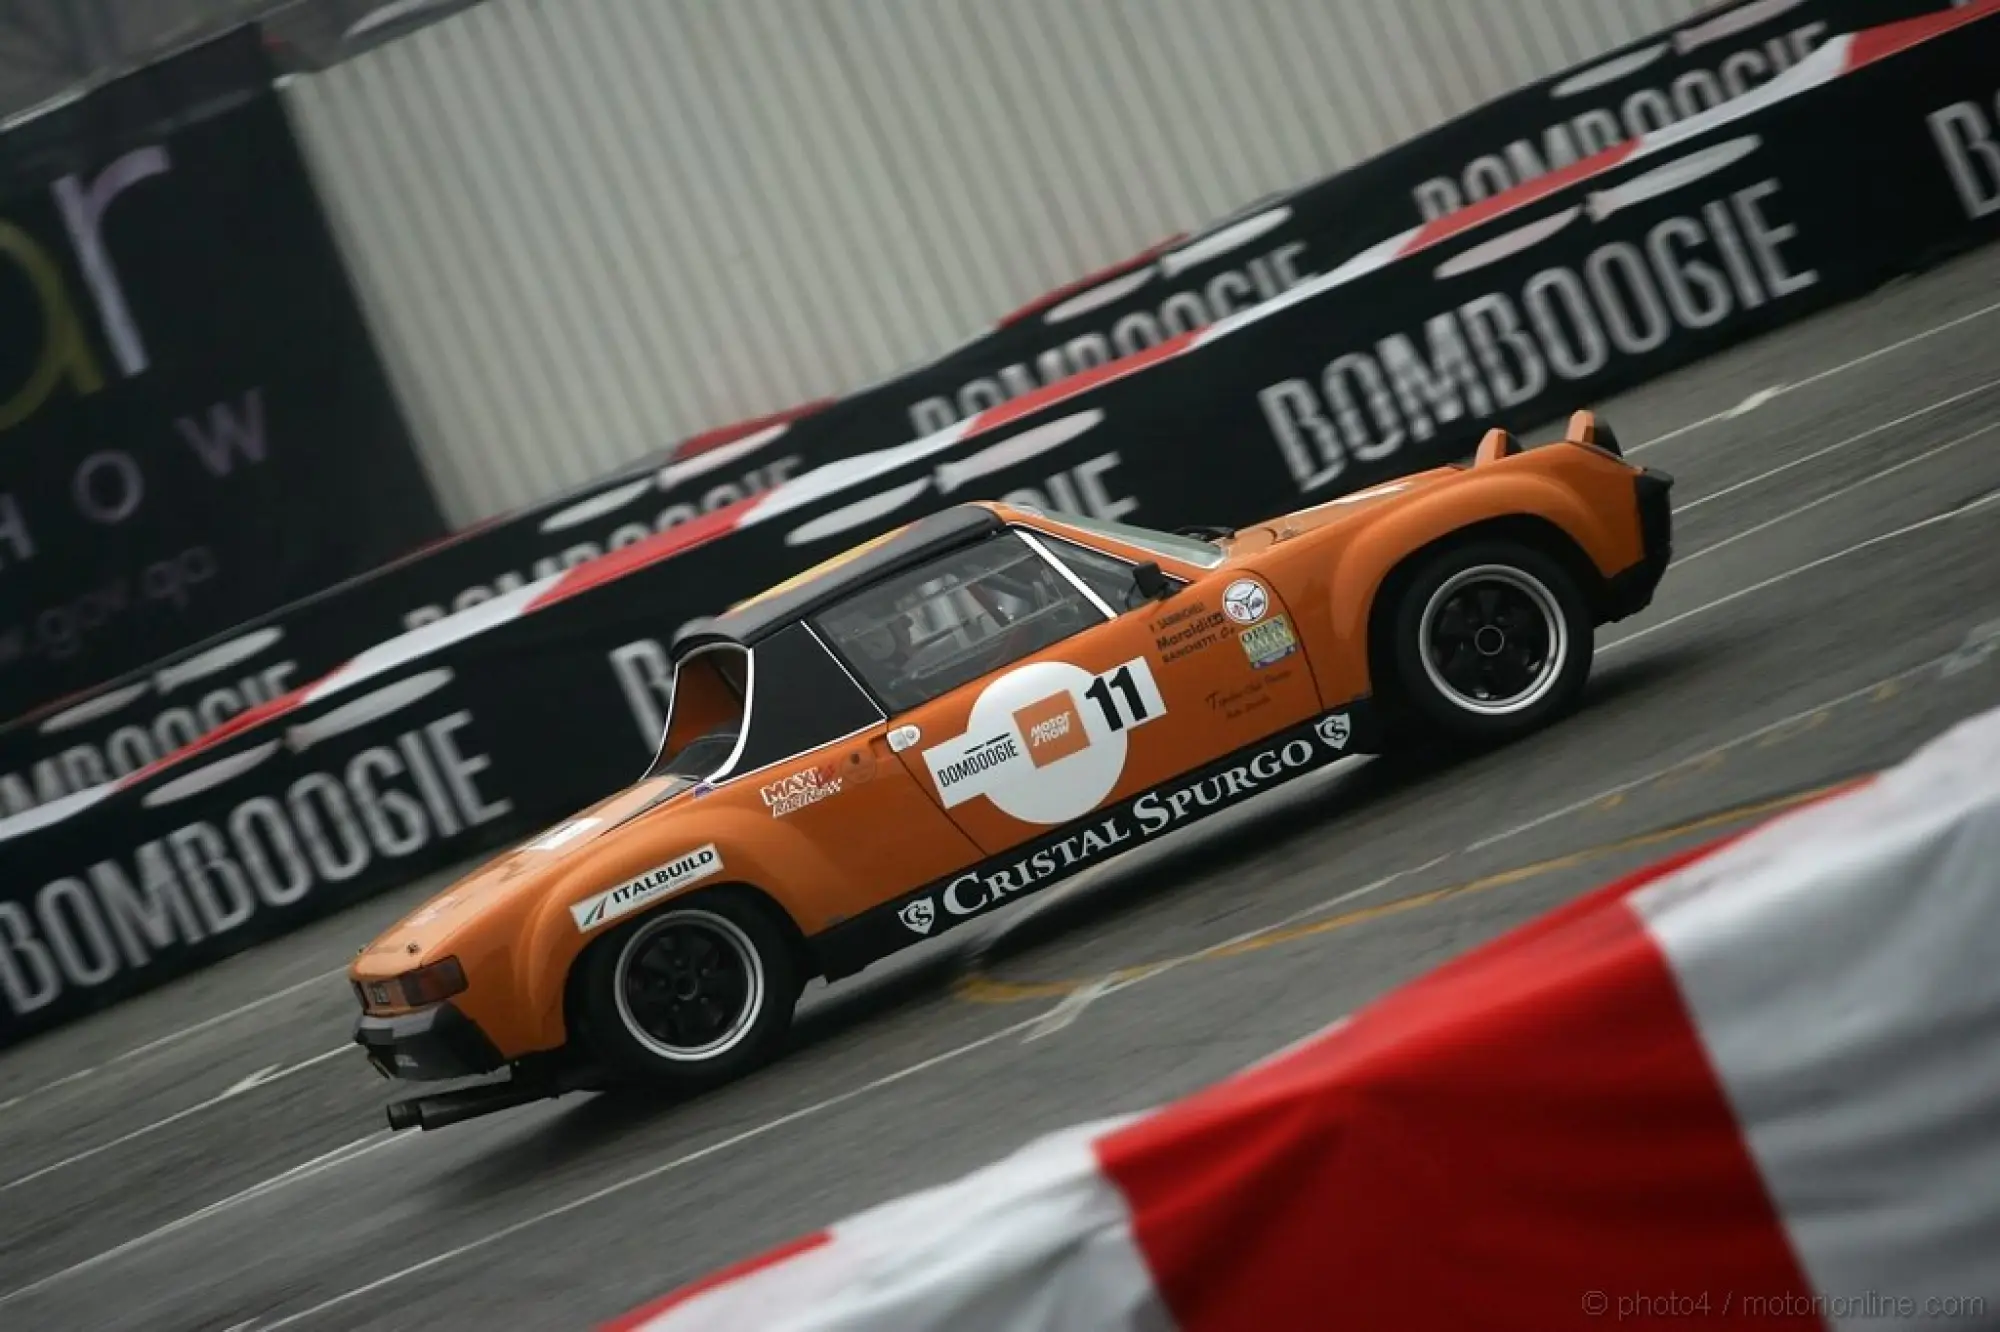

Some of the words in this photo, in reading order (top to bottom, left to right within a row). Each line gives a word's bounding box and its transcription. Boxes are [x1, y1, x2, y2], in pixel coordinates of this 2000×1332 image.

[1258, 179, 1819, 493] BOMBOOGIE
[1085, 665, 1148, 732] 11
[0, 710, 512, 1015] BOMBOOGIE
[612, 850, 714, 904] ITALBUILD
[942, 817, 1131, 917] CRISTAL
[1131, 739, 1314, 836] SPURGO
